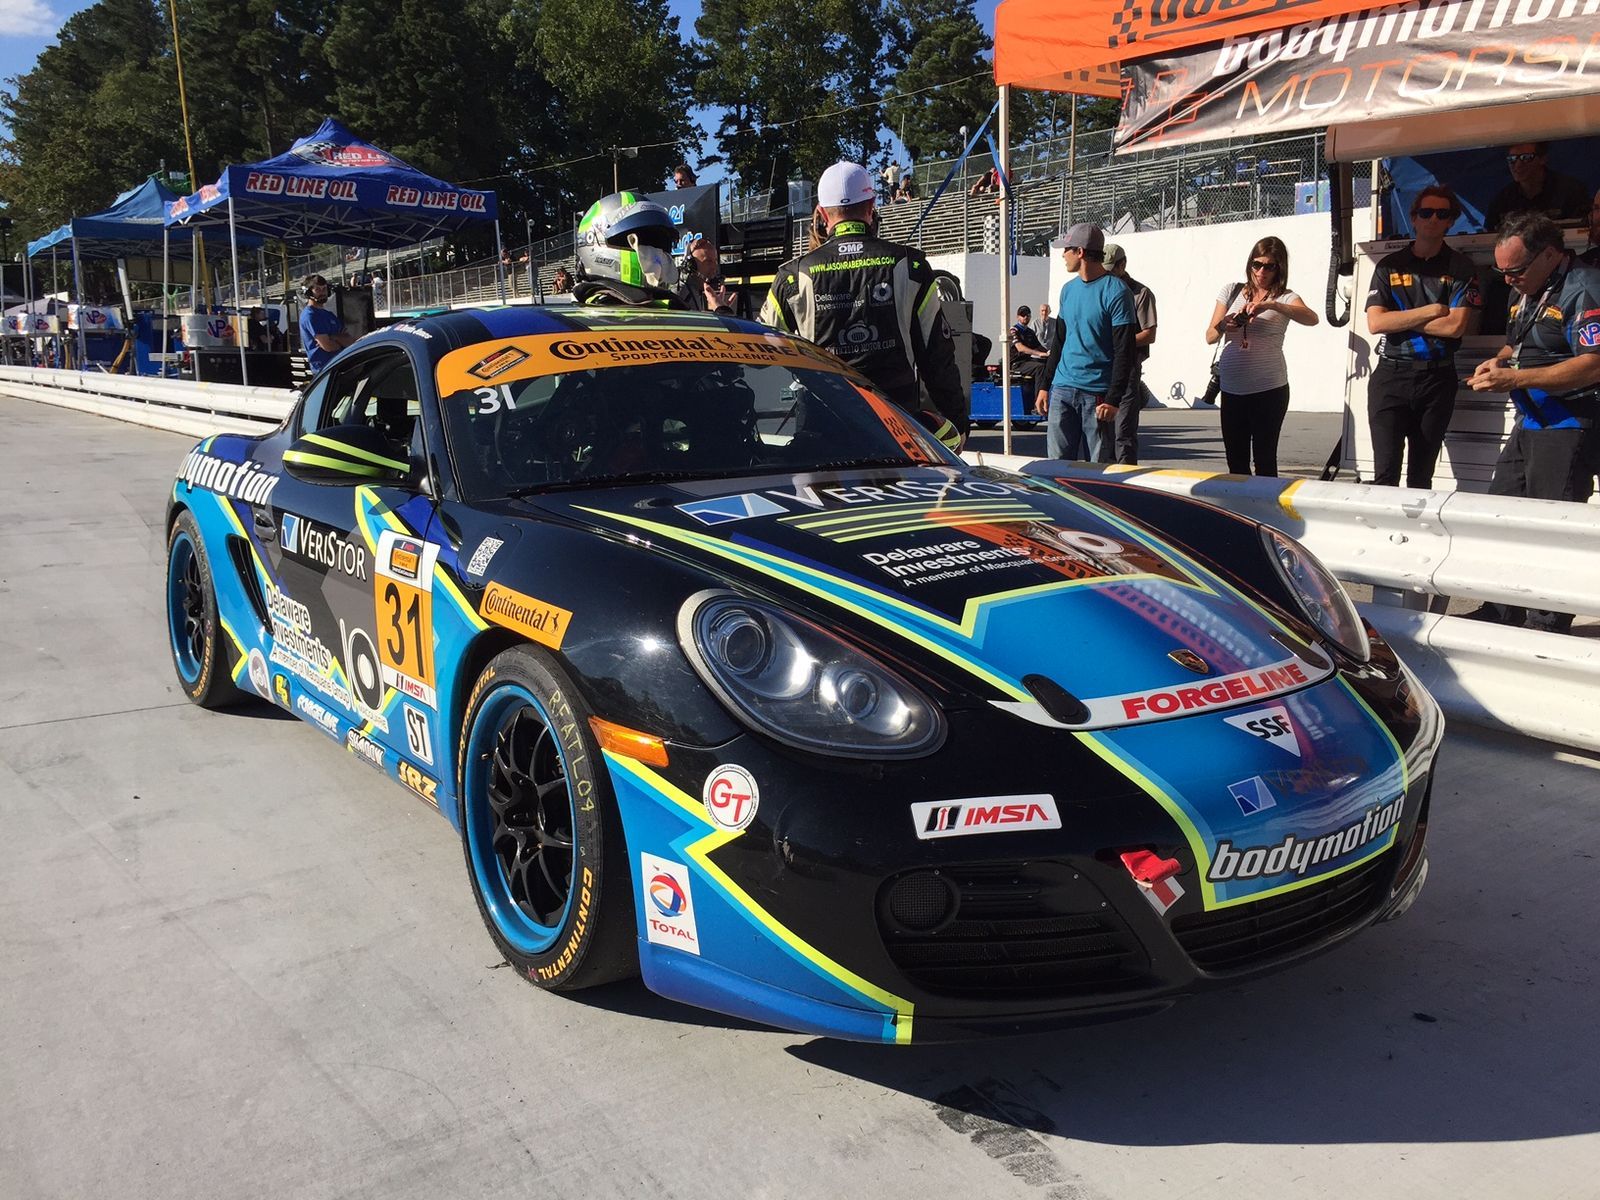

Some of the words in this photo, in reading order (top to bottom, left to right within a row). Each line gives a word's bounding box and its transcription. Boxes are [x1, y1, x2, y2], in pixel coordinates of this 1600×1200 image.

[246, 172, 284, 194] RED
[286, 176, 325, 199] LINE
[328, 180, 358, 201] OIL
[386, 185, 421, 206] RED
[423, 190, 457, 211] LINE
[459, 193, 487, 213] OIL
[838, 242, 864, 253] OMP
[550, 335, 713, 361] Continental
[737, 341, 799, 357] TIRE
[611, 350, 699, 362] SPORTSCAR
[700, 350, 777, 362] CHALLENGE
[474, 385, 517, 414] 31
[862, 539, 981, 567] Delaware
[881, 546, 1029, 577] Investments
[903, 578, 917, 588] A
[917, 568, 968, 586] member
[971, 564, 985, 574] of
[985, 556, 1042, 573] Macquarie
[266, 583, 310, 634] Delaware
[485, 587, 550, 632] Continental
[385, 582, 425, 678] 31
[404, 680, 427, 701] IMSA
[1121, 662, 1308, 720] FORGELINE
[407, 708, 428, 757] ST
[1246, 715, 1291, 740] SSF
[399, 761, 438, 803] JRZ
[711, 778, 751, 823] GT
[964, 803, 1051, 827] IMSA
[1208, 794, 1405, 879] bodymotion
[538, 867, 592, 981] CONTINENTAL
[649, 919, 695, 942] TOTAL
